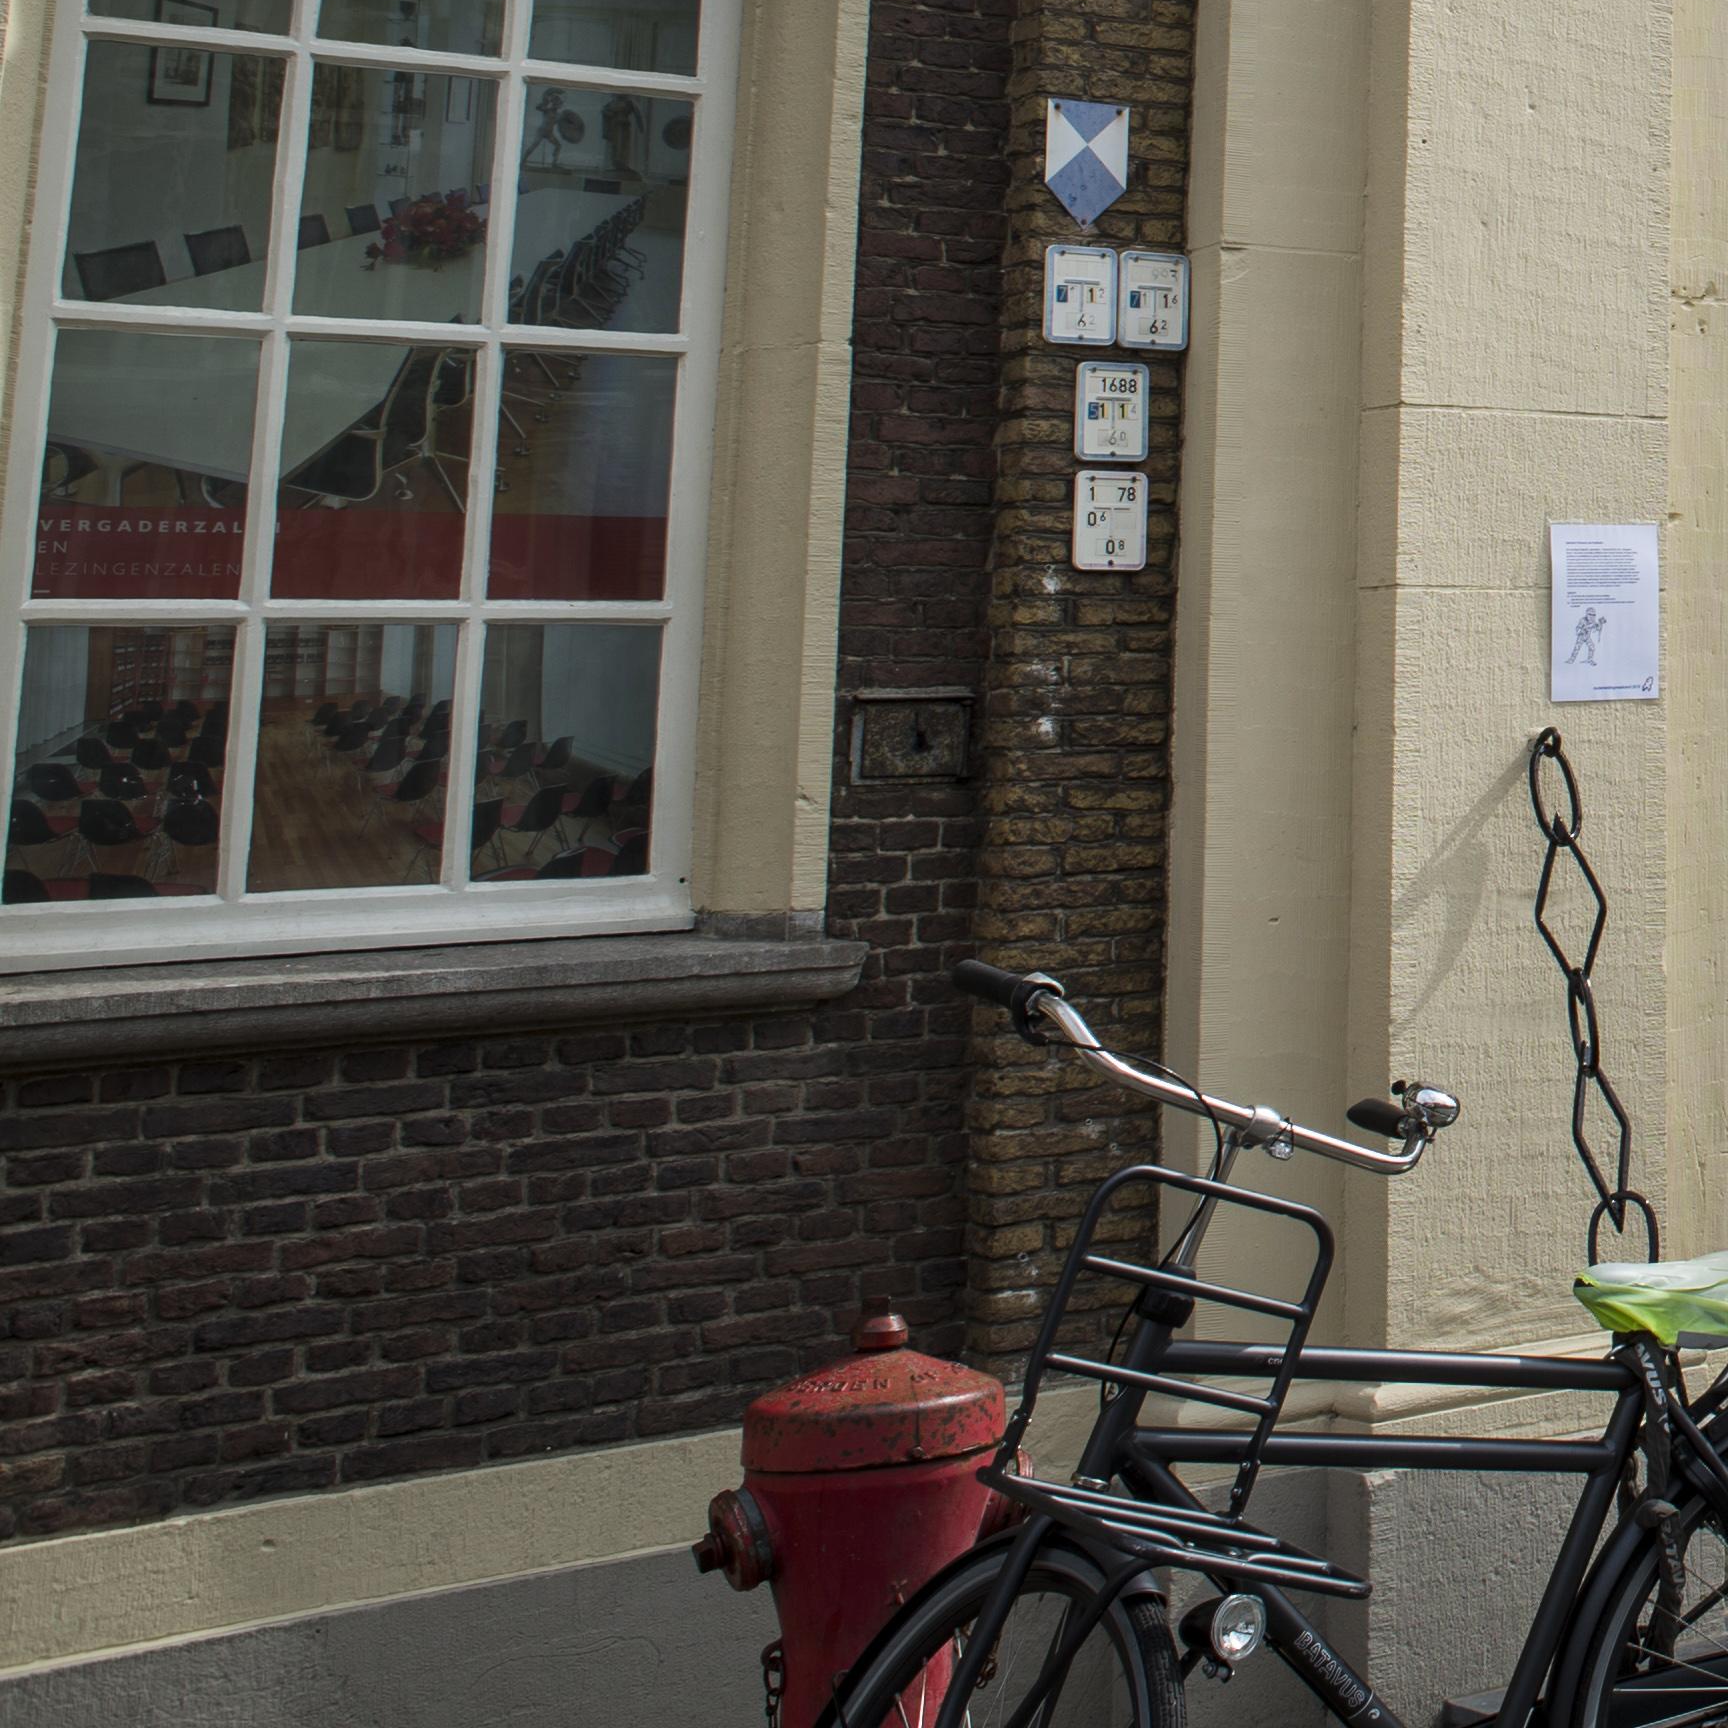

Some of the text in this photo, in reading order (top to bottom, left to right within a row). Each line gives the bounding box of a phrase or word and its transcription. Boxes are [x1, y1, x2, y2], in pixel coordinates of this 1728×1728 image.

[1102, 377, 1137, 393] 1688
[40, 518, 281, 535] VERGADERZAL
[38, 539, 69, 553] EN
[1294, 1629, 1366, 1708] BATAVUS
